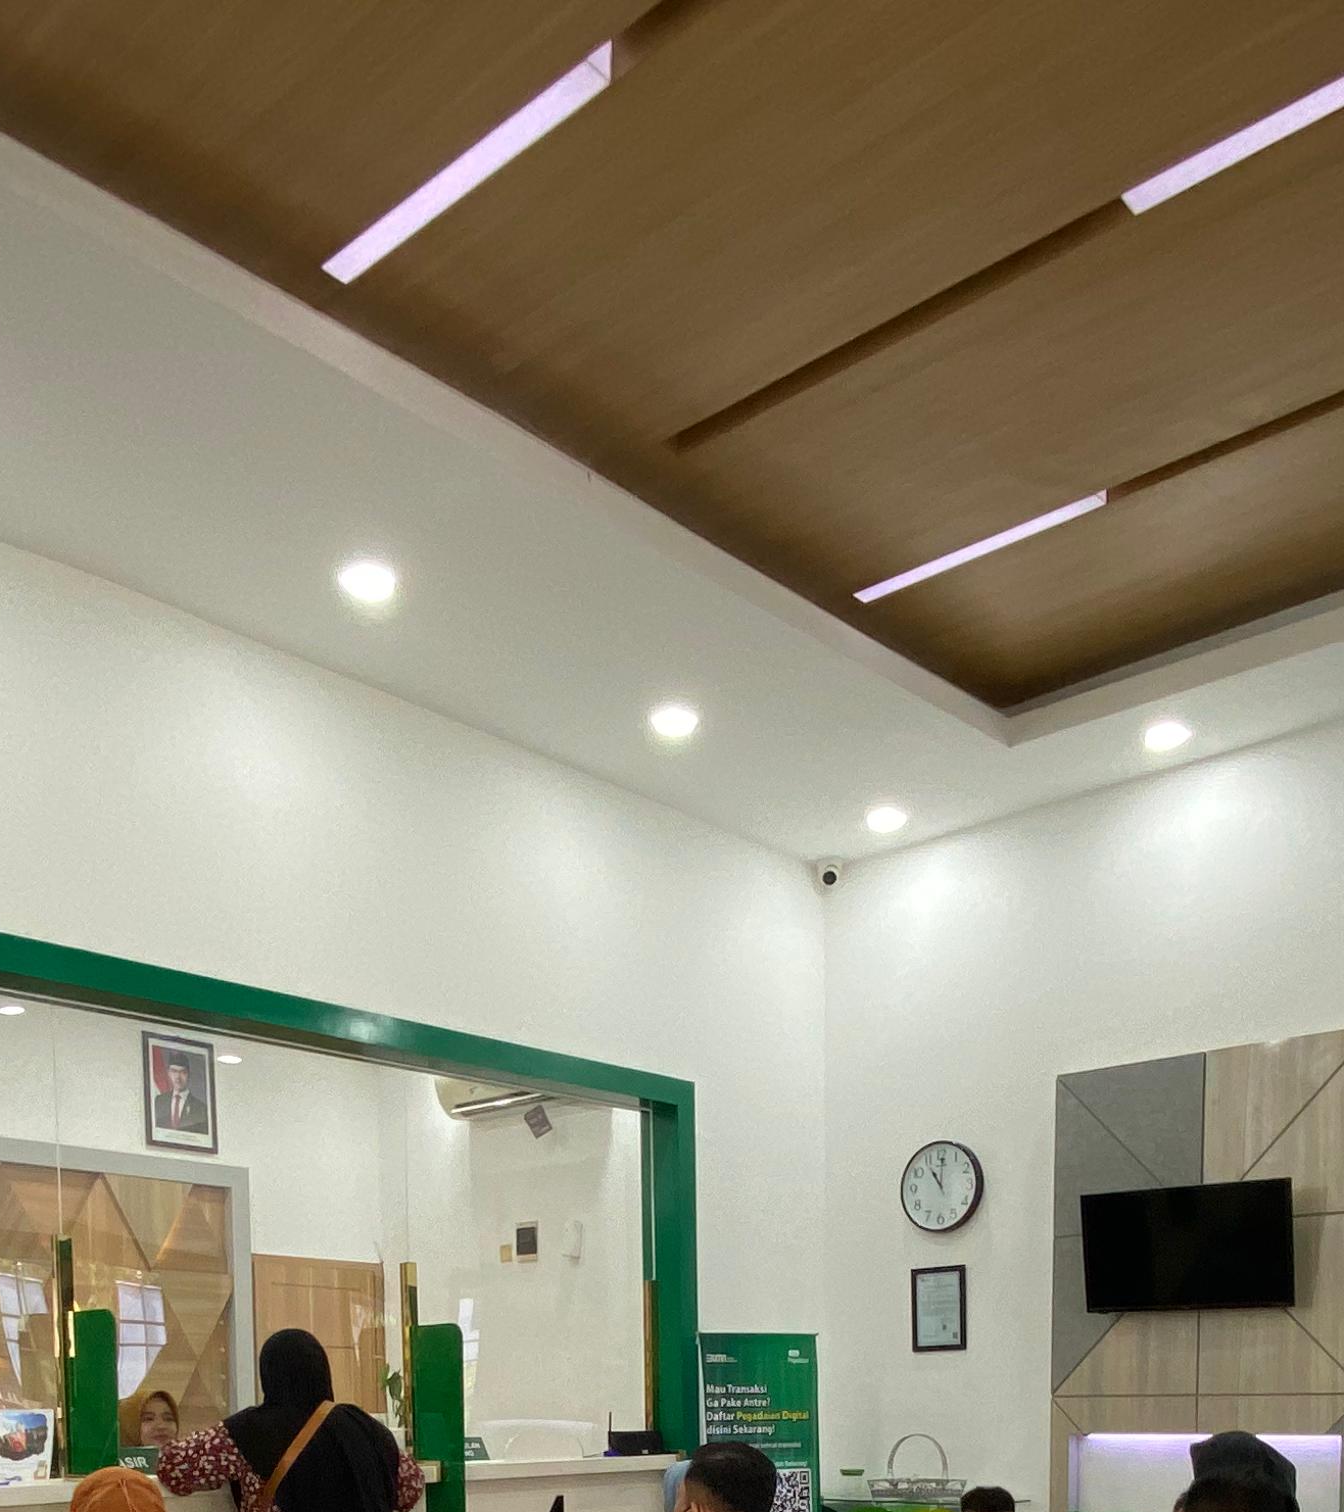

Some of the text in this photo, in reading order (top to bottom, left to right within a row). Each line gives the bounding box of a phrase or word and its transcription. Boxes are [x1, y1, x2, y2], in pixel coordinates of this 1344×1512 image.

[962, 1161, 970, 1174] 2
[706, 1384, 768, 1394] Mau Transaksi
[706, 1398, 719, 1408] Ga
[720, 1398, 742, 1408] Pake
[706, 1411, 735, 1421] Daftar
[706, 1424, 732, 1435] disini
